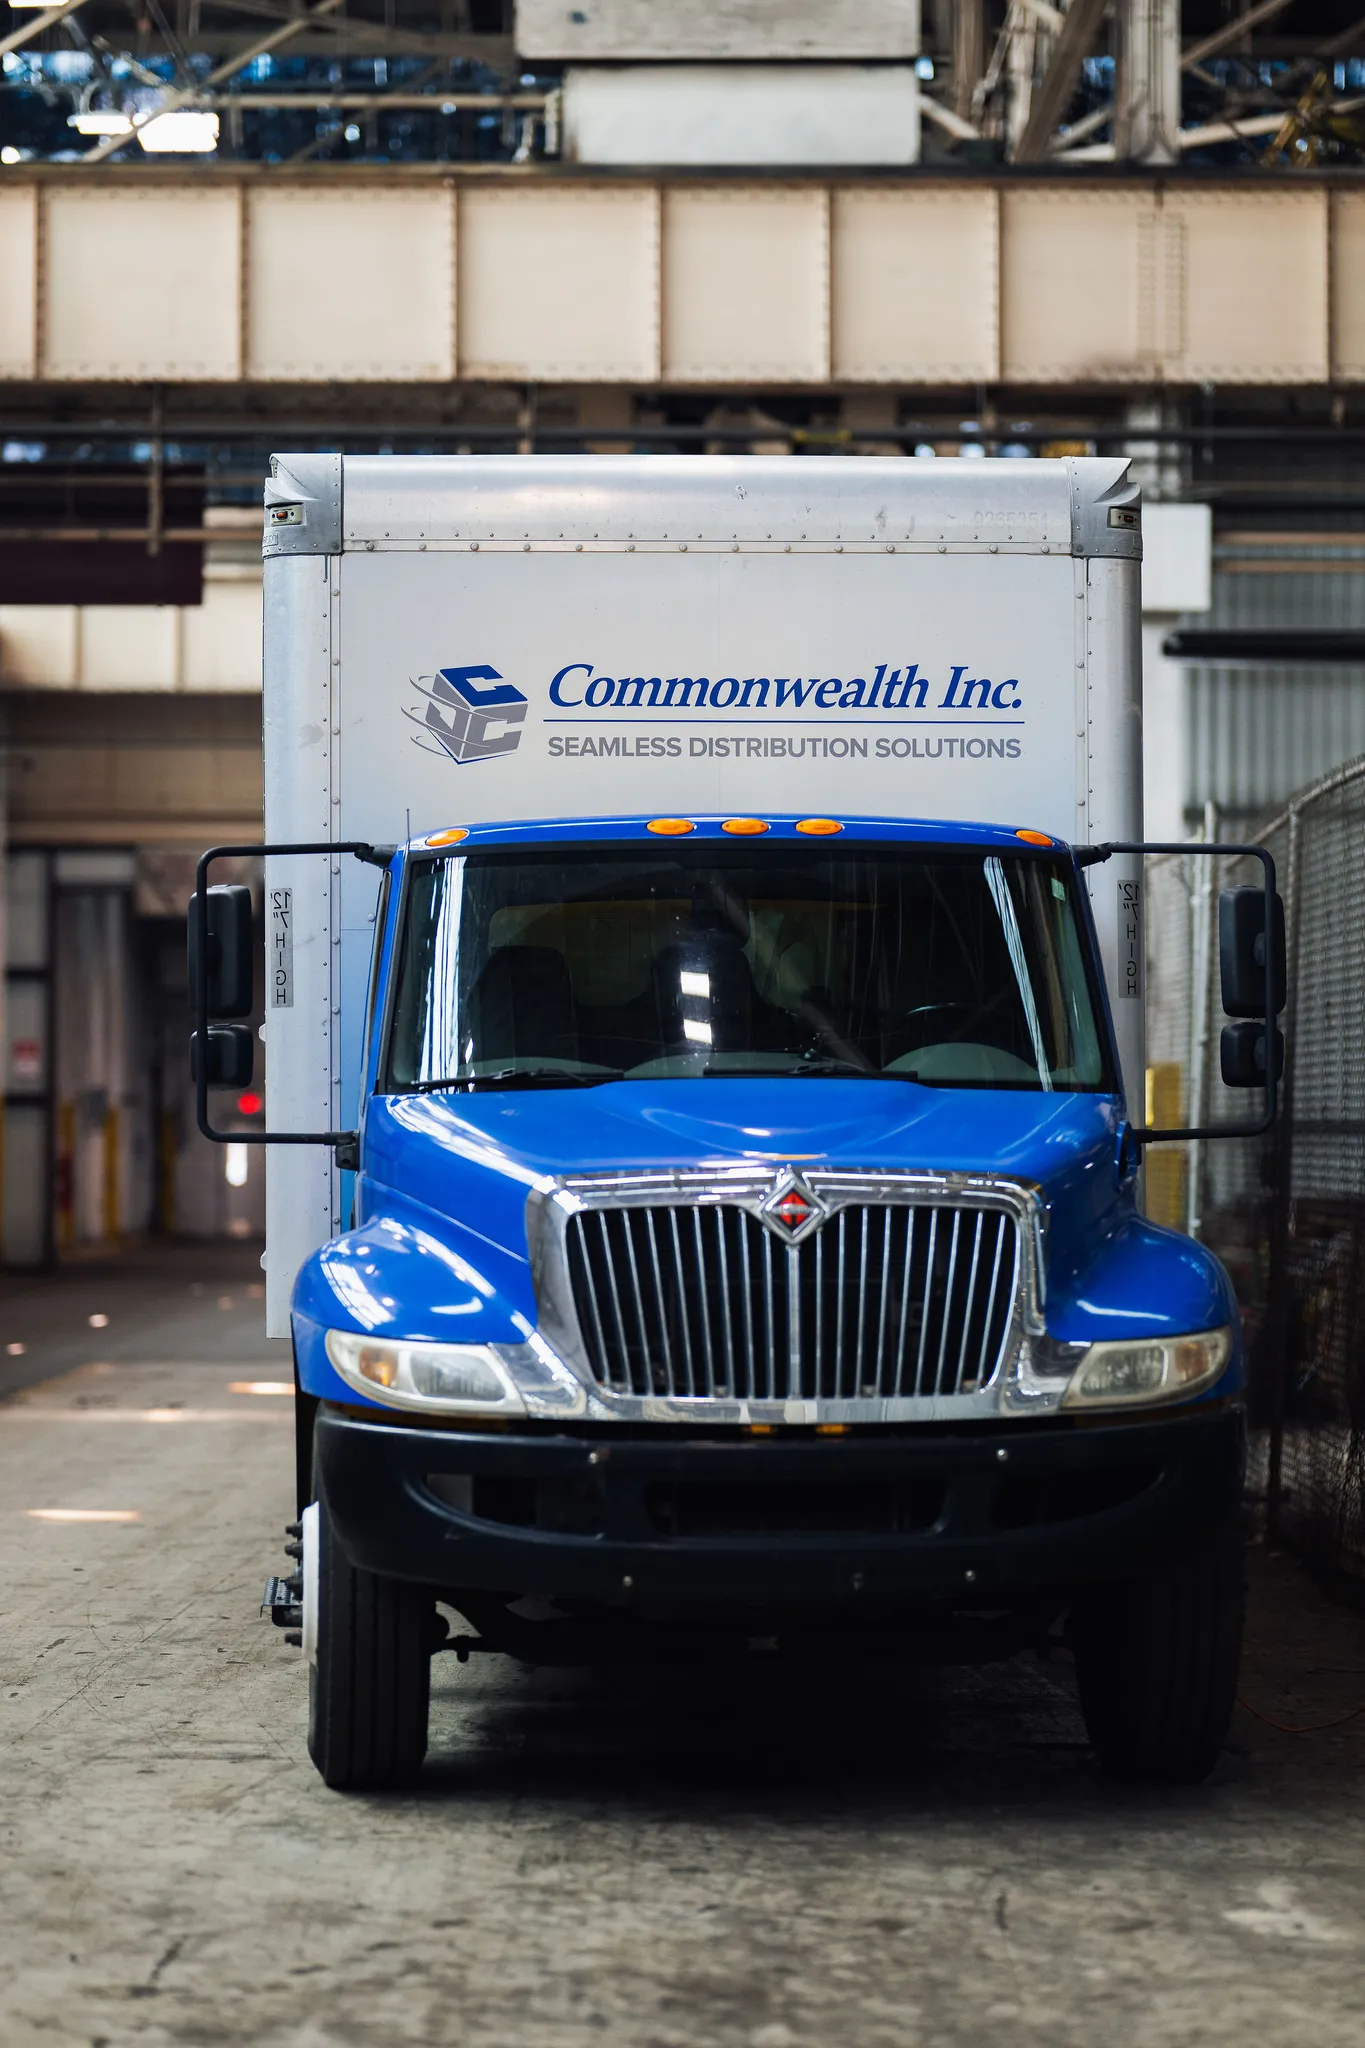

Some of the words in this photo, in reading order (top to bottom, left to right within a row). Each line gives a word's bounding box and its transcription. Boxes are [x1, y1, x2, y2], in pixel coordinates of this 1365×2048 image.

[548, 663, 930, 709] Commonwealth
[937, 666, 1022, 709] Inc.
[547, 736, 682, 757] SEAMLESS
[689, 737, 868, 758] DISTRIBUTION
[875, 738, 1022, 758] SOLUTIONS
